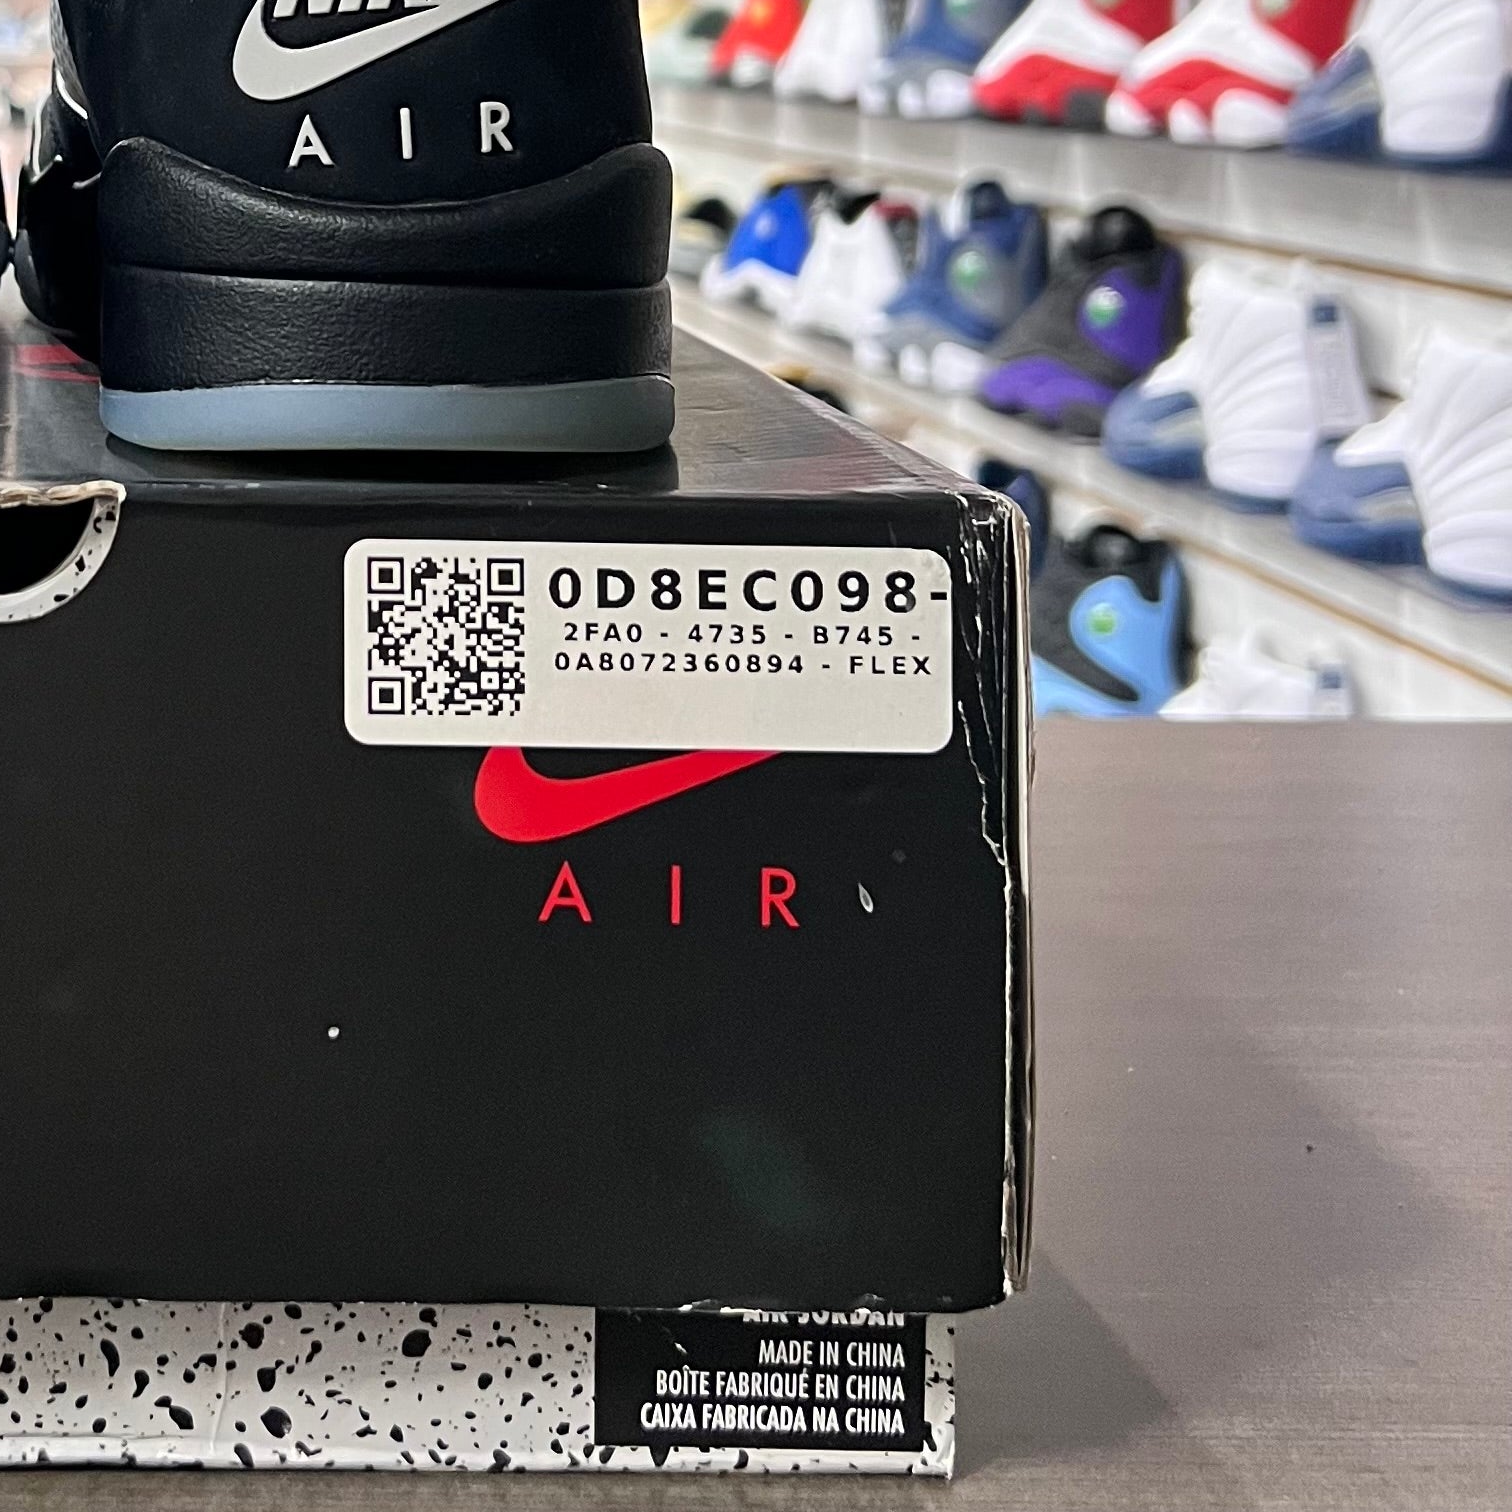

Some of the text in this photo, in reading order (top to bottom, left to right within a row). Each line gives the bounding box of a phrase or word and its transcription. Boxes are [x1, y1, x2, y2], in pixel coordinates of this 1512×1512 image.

[288, 101, 514, 167] AIR
[688, 624, 767, 645] 4735
[813, 625, 894, 646] B745
[849, 655, 932, 676] FLEX
[538, 859, 800, 928] AIR
[759, 1339, 905, 1368] MADE IN CHINA
[656, 1365, 905, 1401] BOÎTE FABRIQUÉ EN CHINA
[640, 1402, 905, 1434] CAIXA FABRICADA NA CHINA
